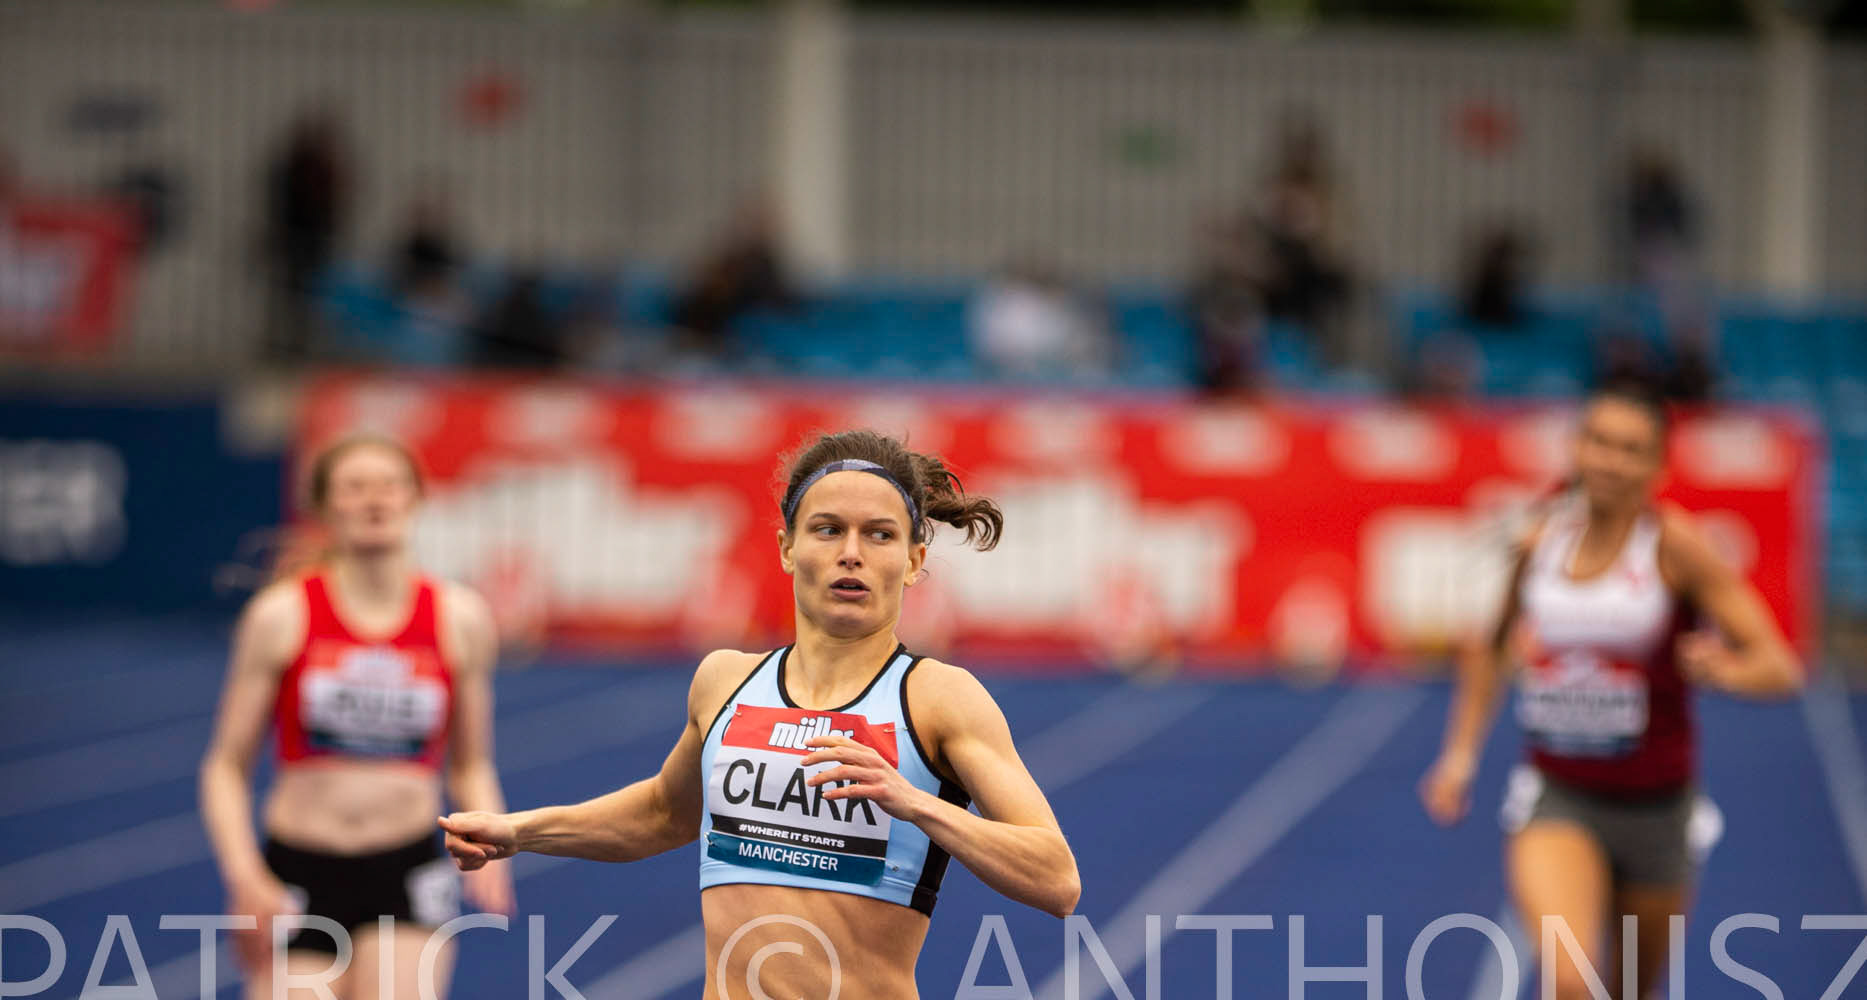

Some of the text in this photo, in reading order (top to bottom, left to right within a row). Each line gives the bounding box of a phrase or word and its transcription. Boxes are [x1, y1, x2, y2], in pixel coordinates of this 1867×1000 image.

[722, 758, 878, 826] CLARK
[739, 823, 845, 848] #WHERE IT STARTS
[738, 841, 838, 872] MANCHESTER
